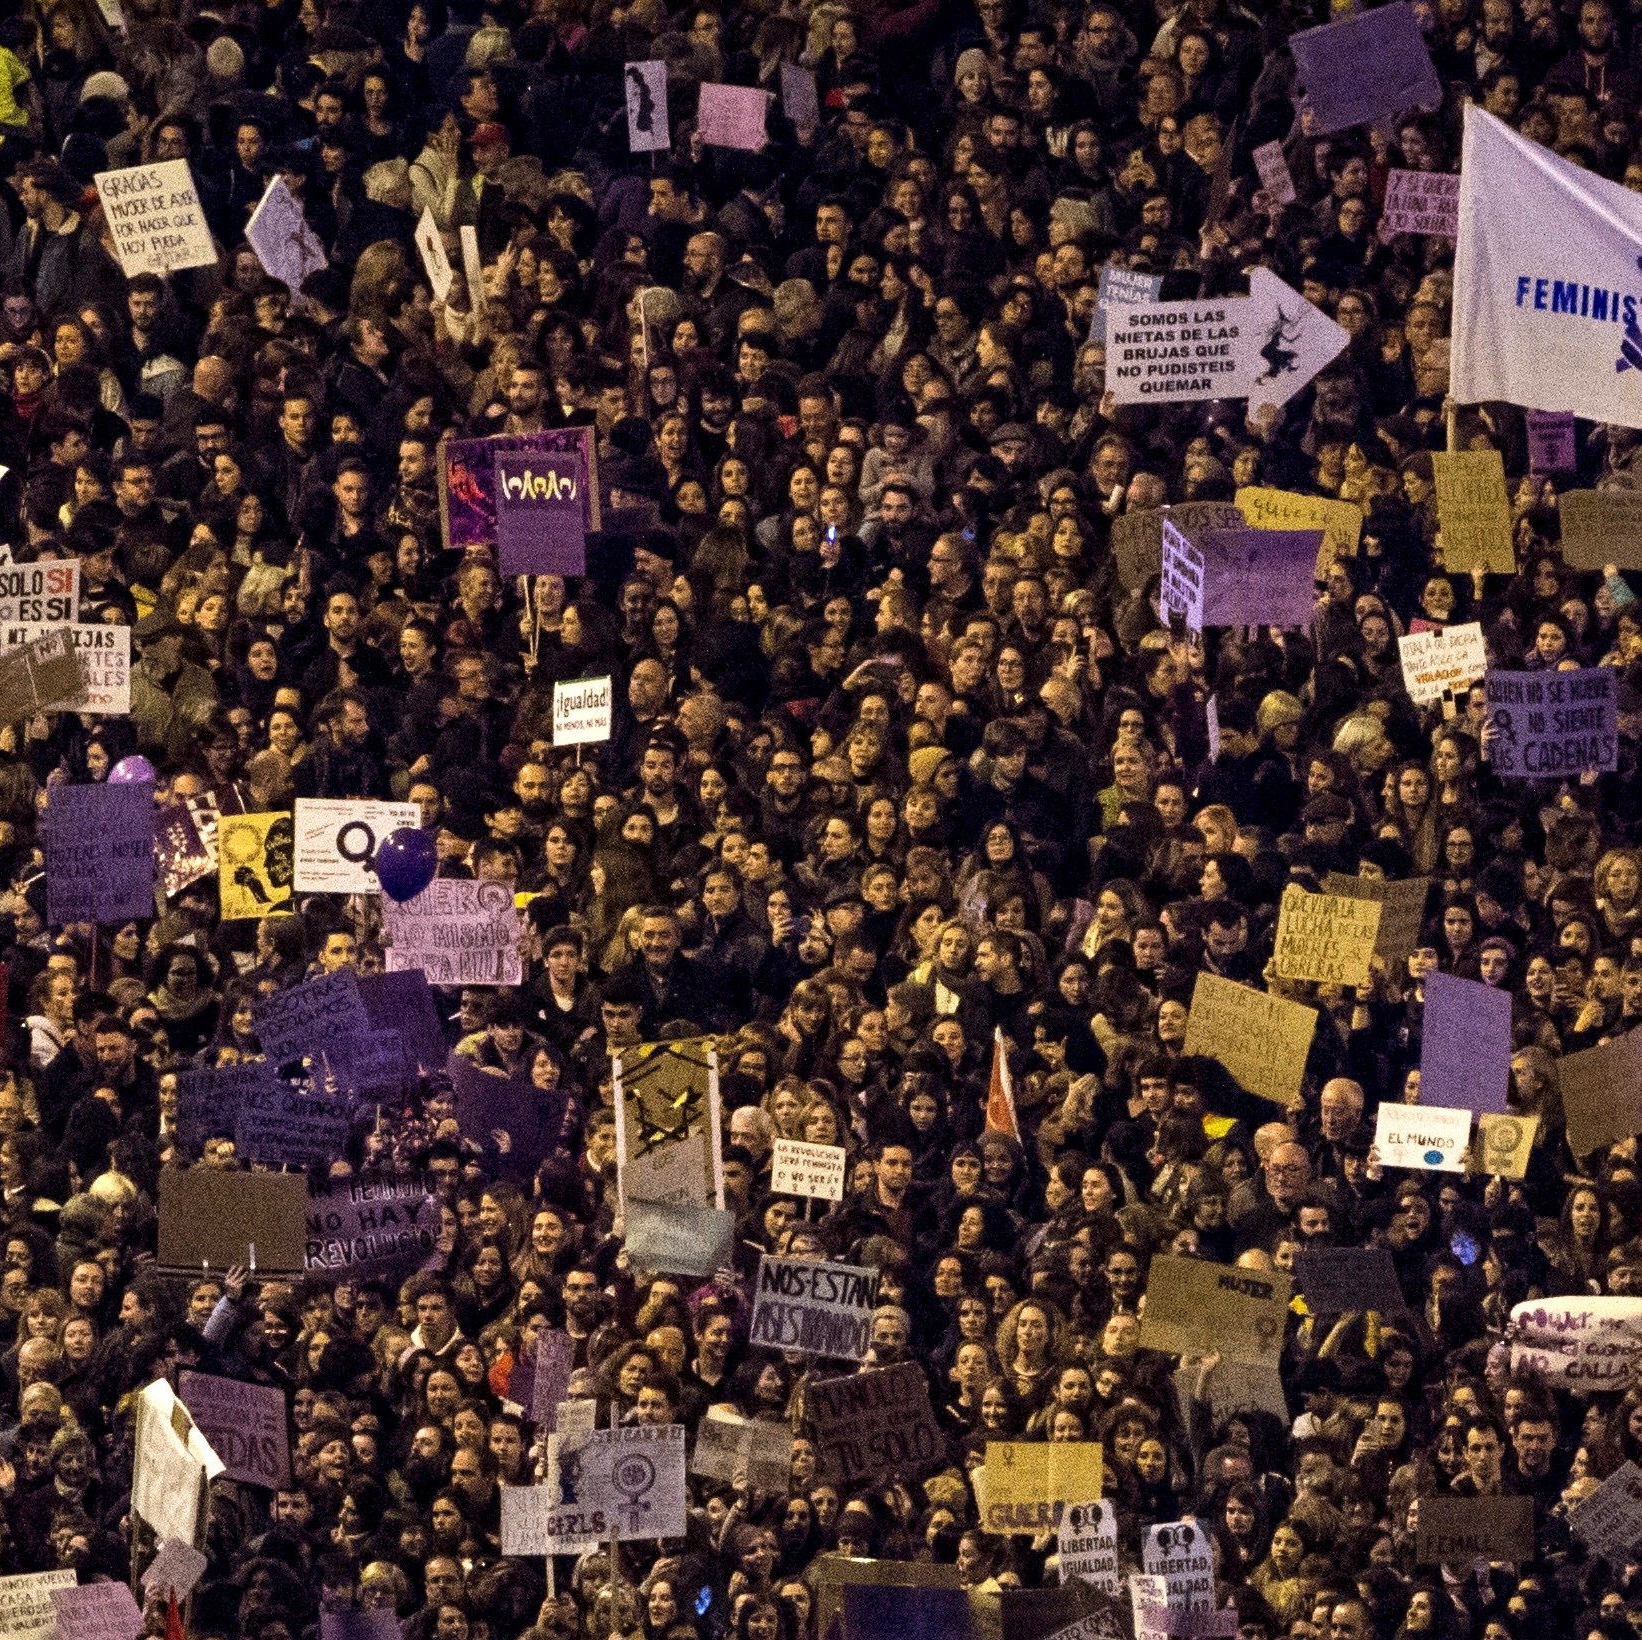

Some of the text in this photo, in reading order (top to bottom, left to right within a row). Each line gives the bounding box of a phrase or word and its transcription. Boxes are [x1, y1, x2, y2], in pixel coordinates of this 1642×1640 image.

[107, 170, 163, 198] GRACIAS
[112, 199, 148, 218] MUJER
[173, 215, 198, 231] QUE
[123, 240, 145, 255] HOY
[1129, 312, 1225, 326] SOMOS LAS
[1115, 326, 1239, 344] NIETAS DE LAS
[1124, 344, 1229, 361] BRUJAS QUE
[1117, 360, 1235, 377] NO PUDISTEIS
[1139, 378, 1211, 394] QUEMAR
[47, 568, 72, 594] SI
[19, 598, 71, 622] ES SI
[561, 691, 607, 718] ¡Igualdad!
[1524, 736, 1613, 772] CADENAS
[1285, 916, 1333, 938] LUCHA
[1284, 954, 1345, 980] OBRERAS
[1387, 1132, 1455, 1148] EL MUNDO
[359, 1201, 419, 1232] HAY
[869, 1422, 935, 1467] SOLO
[1061, 1536, 1115, 1554] LIBERTAD,
[1062, 1556, 1115, 1574] IGUALDAD,
[1148, 1558, 1208, 1576] LIBERTAD,
